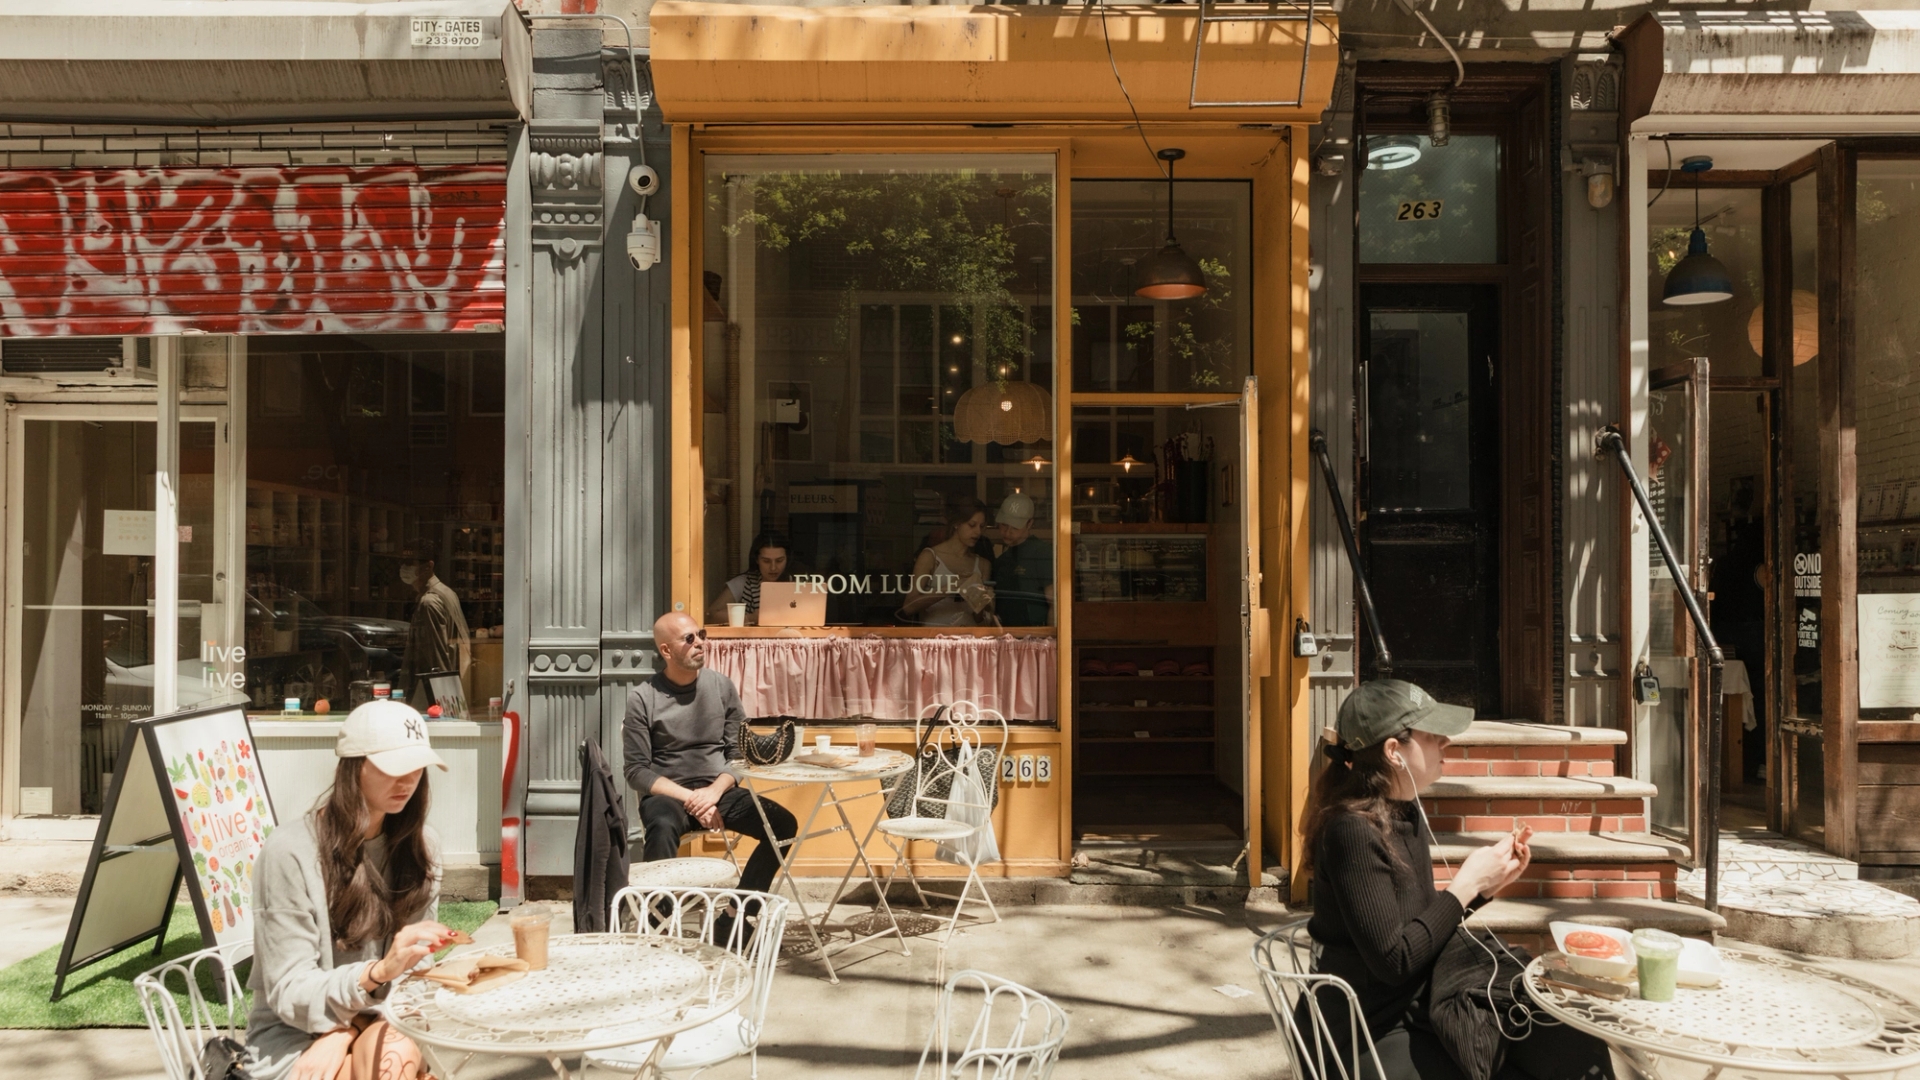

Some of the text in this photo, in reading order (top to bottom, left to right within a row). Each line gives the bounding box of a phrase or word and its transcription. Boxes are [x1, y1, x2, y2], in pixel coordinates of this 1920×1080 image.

[1398, 201, 1442, 220] 263
[790, 494, 838, 504] FLEURS.
[1807, 553, 1822, 574] NO
[794, 574, 968, 594] FROM LUCIE.
[1794, 576, 1822, 588] OUTSIDE
[1878, 606, 1909, 620] Coming
[202, 640, 246, 662] live
[202, 666, 246, 688] live
[1004, 760, 1048, 778] 263
[208, 812, 248, 843] live
[219, 836, 253, 858] organic
